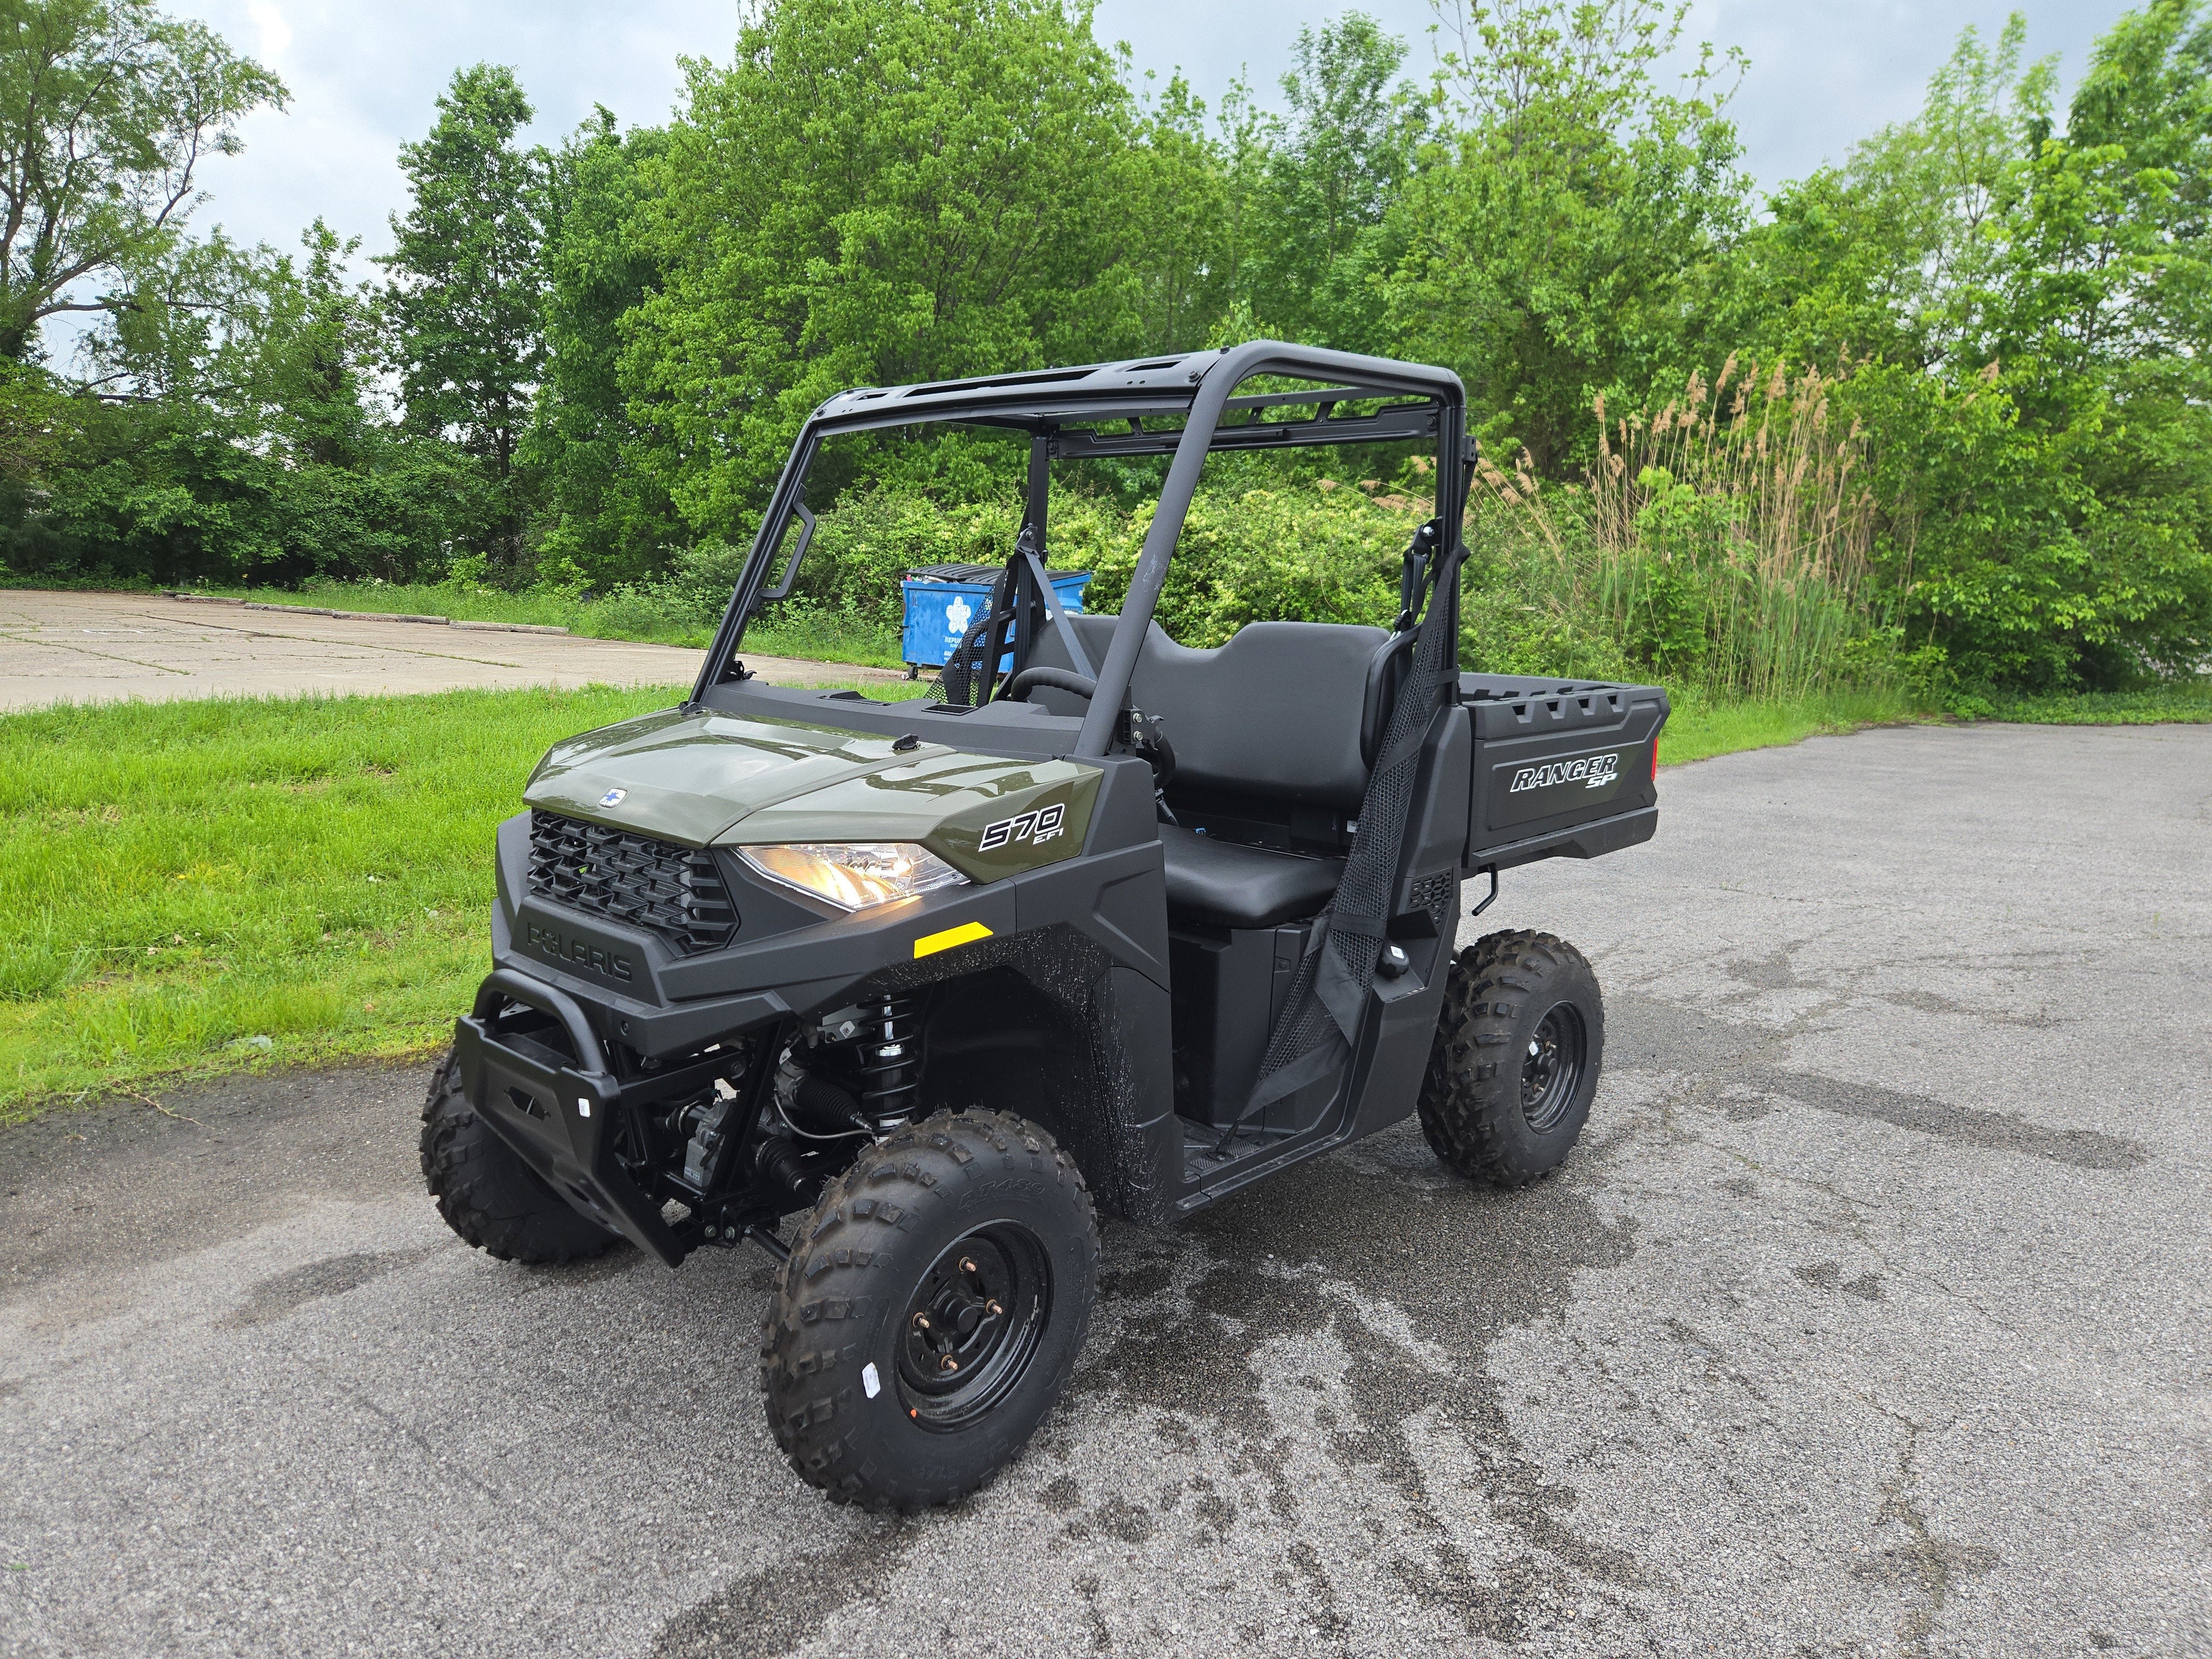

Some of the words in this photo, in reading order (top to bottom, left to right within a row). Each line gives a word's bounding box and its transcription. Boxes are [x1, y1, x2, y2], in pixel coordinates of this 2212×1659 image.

[1510, 754, 1618, 792] RANGER
[1585, 773, 1618, 788] SP
[979, 803, 1065, 852] 570
[1033, 828, 1064, 845] EFI
[528, 922, 633, 982] POLARIS
